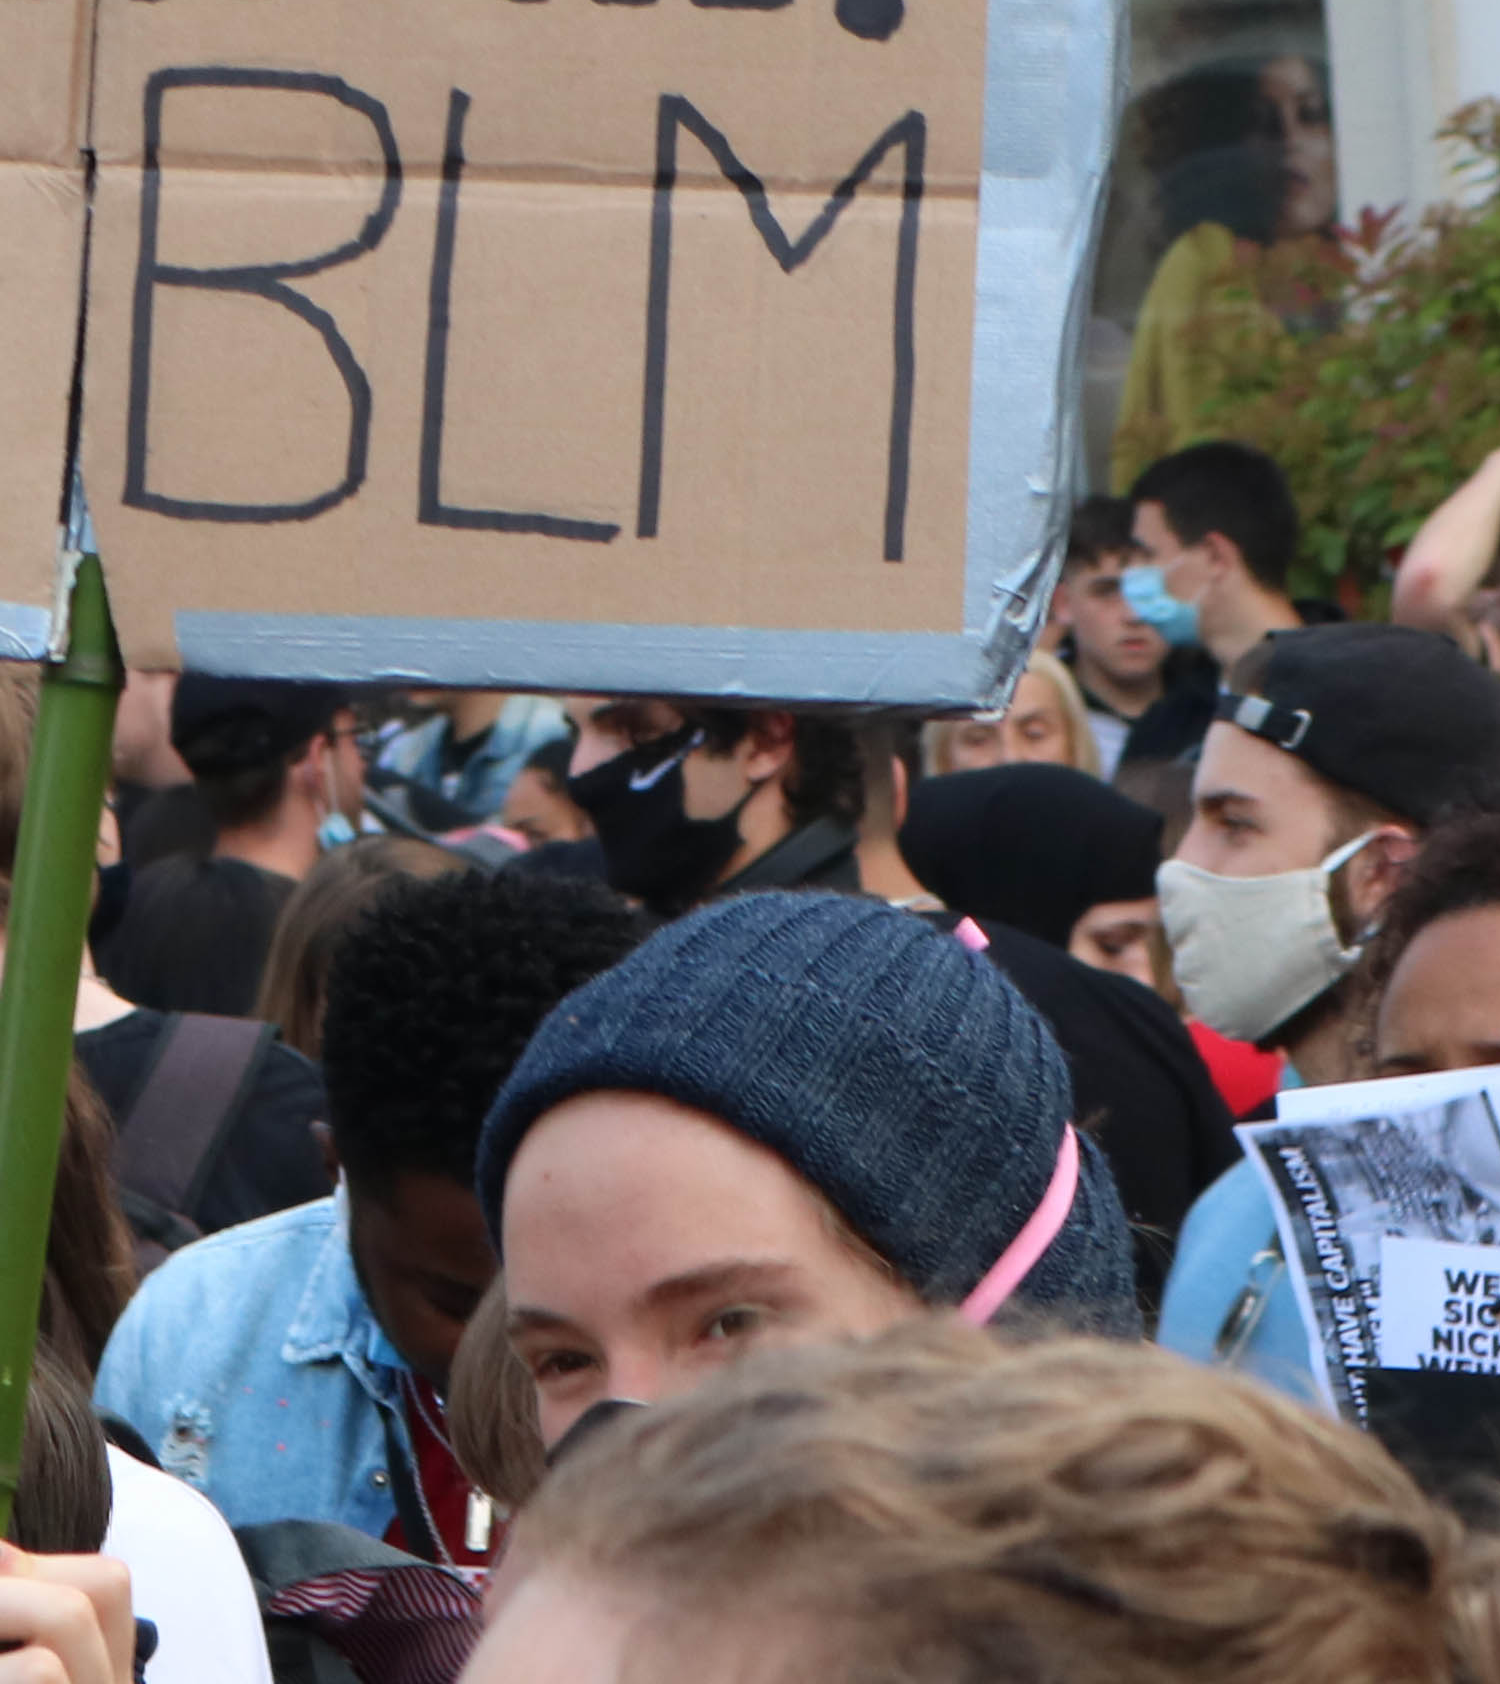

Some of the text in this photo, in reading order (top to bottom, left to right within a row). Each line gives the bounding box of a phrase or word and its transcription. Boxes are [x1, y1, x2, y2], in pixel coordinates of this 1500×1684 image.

[121, 65, 927, 565] BLM
[1277, 1146, 1351, 1291] CAPITALISM
[1331, 1296, 1368, 1367] HAVE
